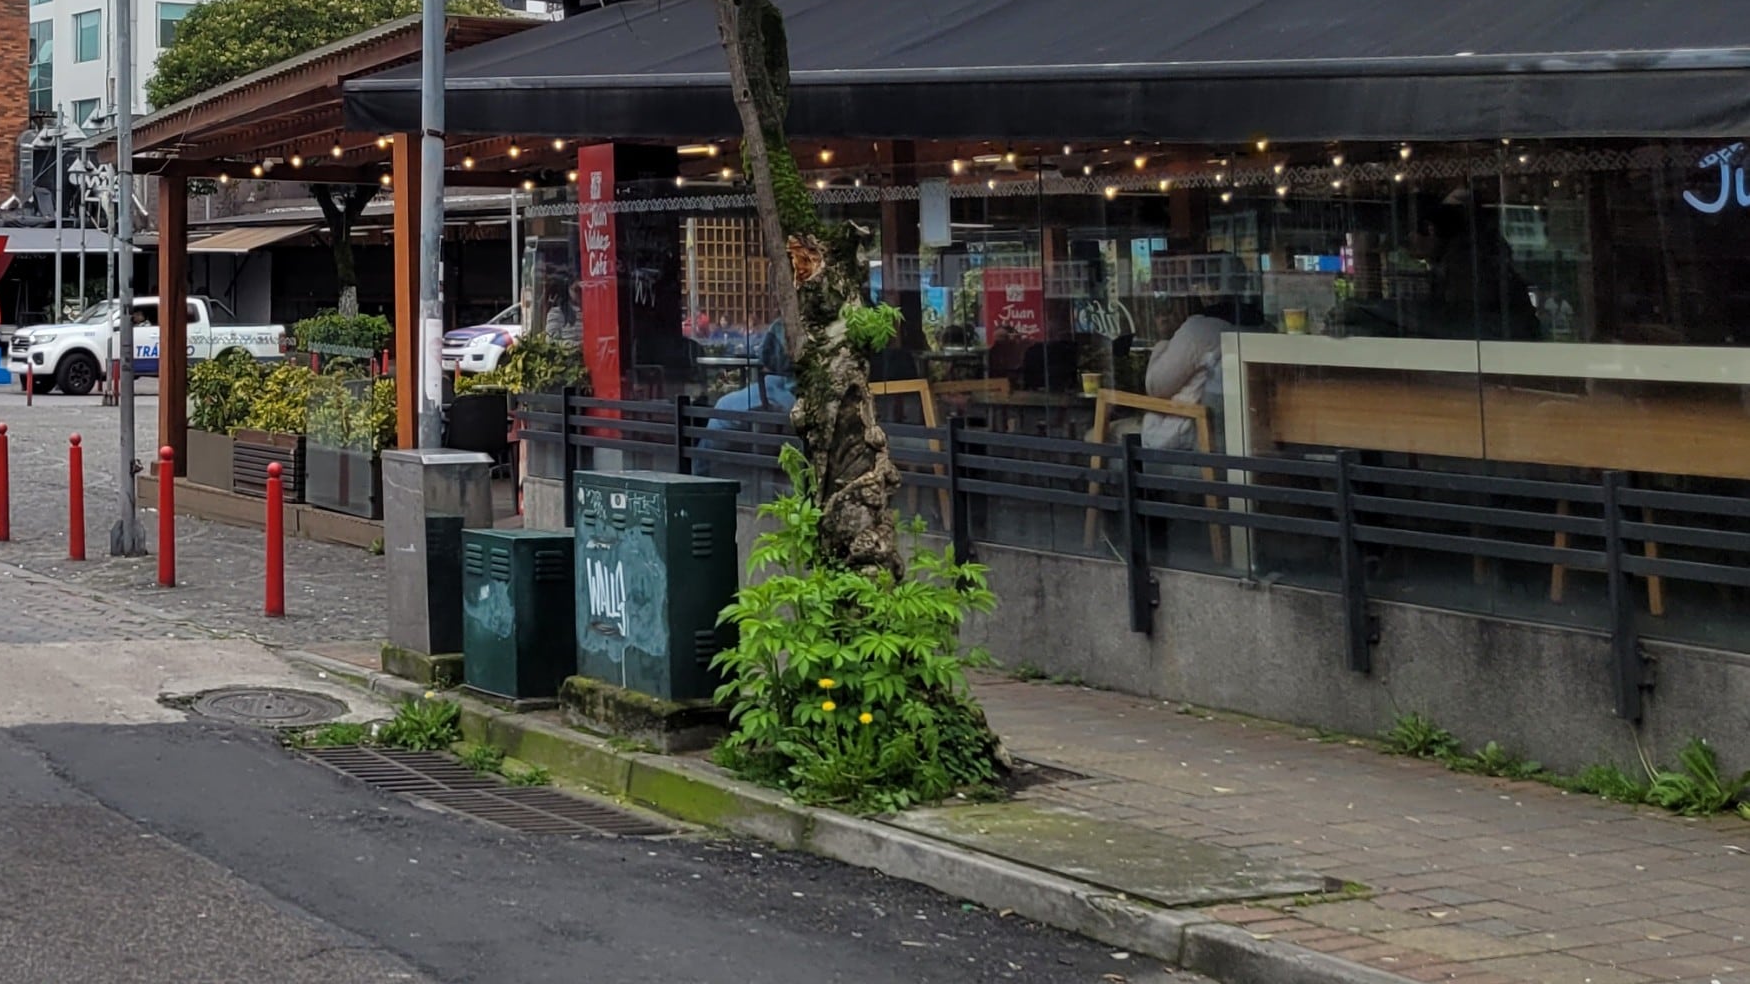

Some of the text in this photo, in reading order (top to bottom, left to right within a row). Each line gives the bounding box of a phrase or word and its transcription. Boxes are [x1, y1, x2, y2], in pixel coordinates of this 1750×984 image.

[589, 251, 608, 277] Café
[998, 303, 1035, 320] Juan
[136, 342, 196, 358] TRÁO
